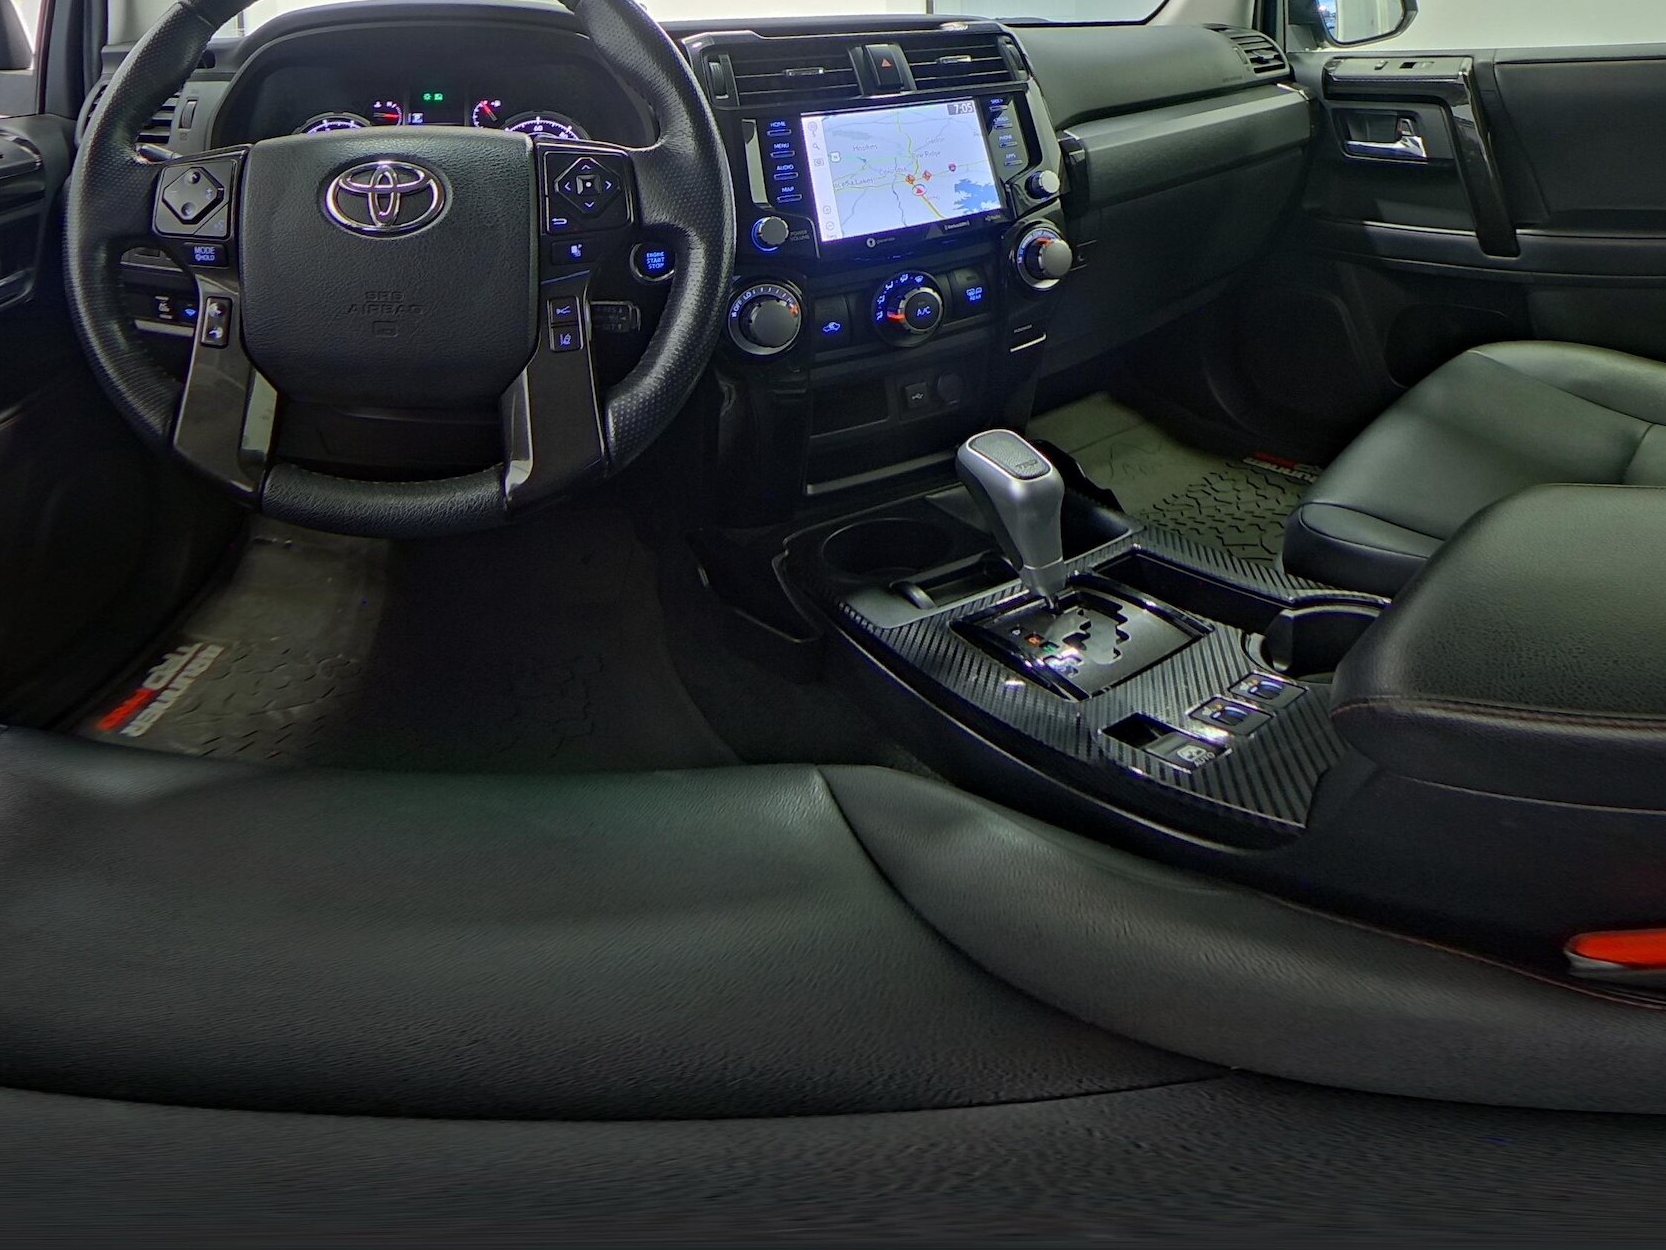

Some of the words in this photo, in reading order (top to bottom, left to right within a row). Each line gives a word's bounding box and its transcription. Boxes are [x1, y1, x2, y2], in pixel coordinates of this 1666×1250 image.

[954, 102, 973, 113] 7:05
[194, 246, 215, 255] MODE
[916, 306, 932, 316] A/C
[1193, 752, 1216, 767] AUTO
